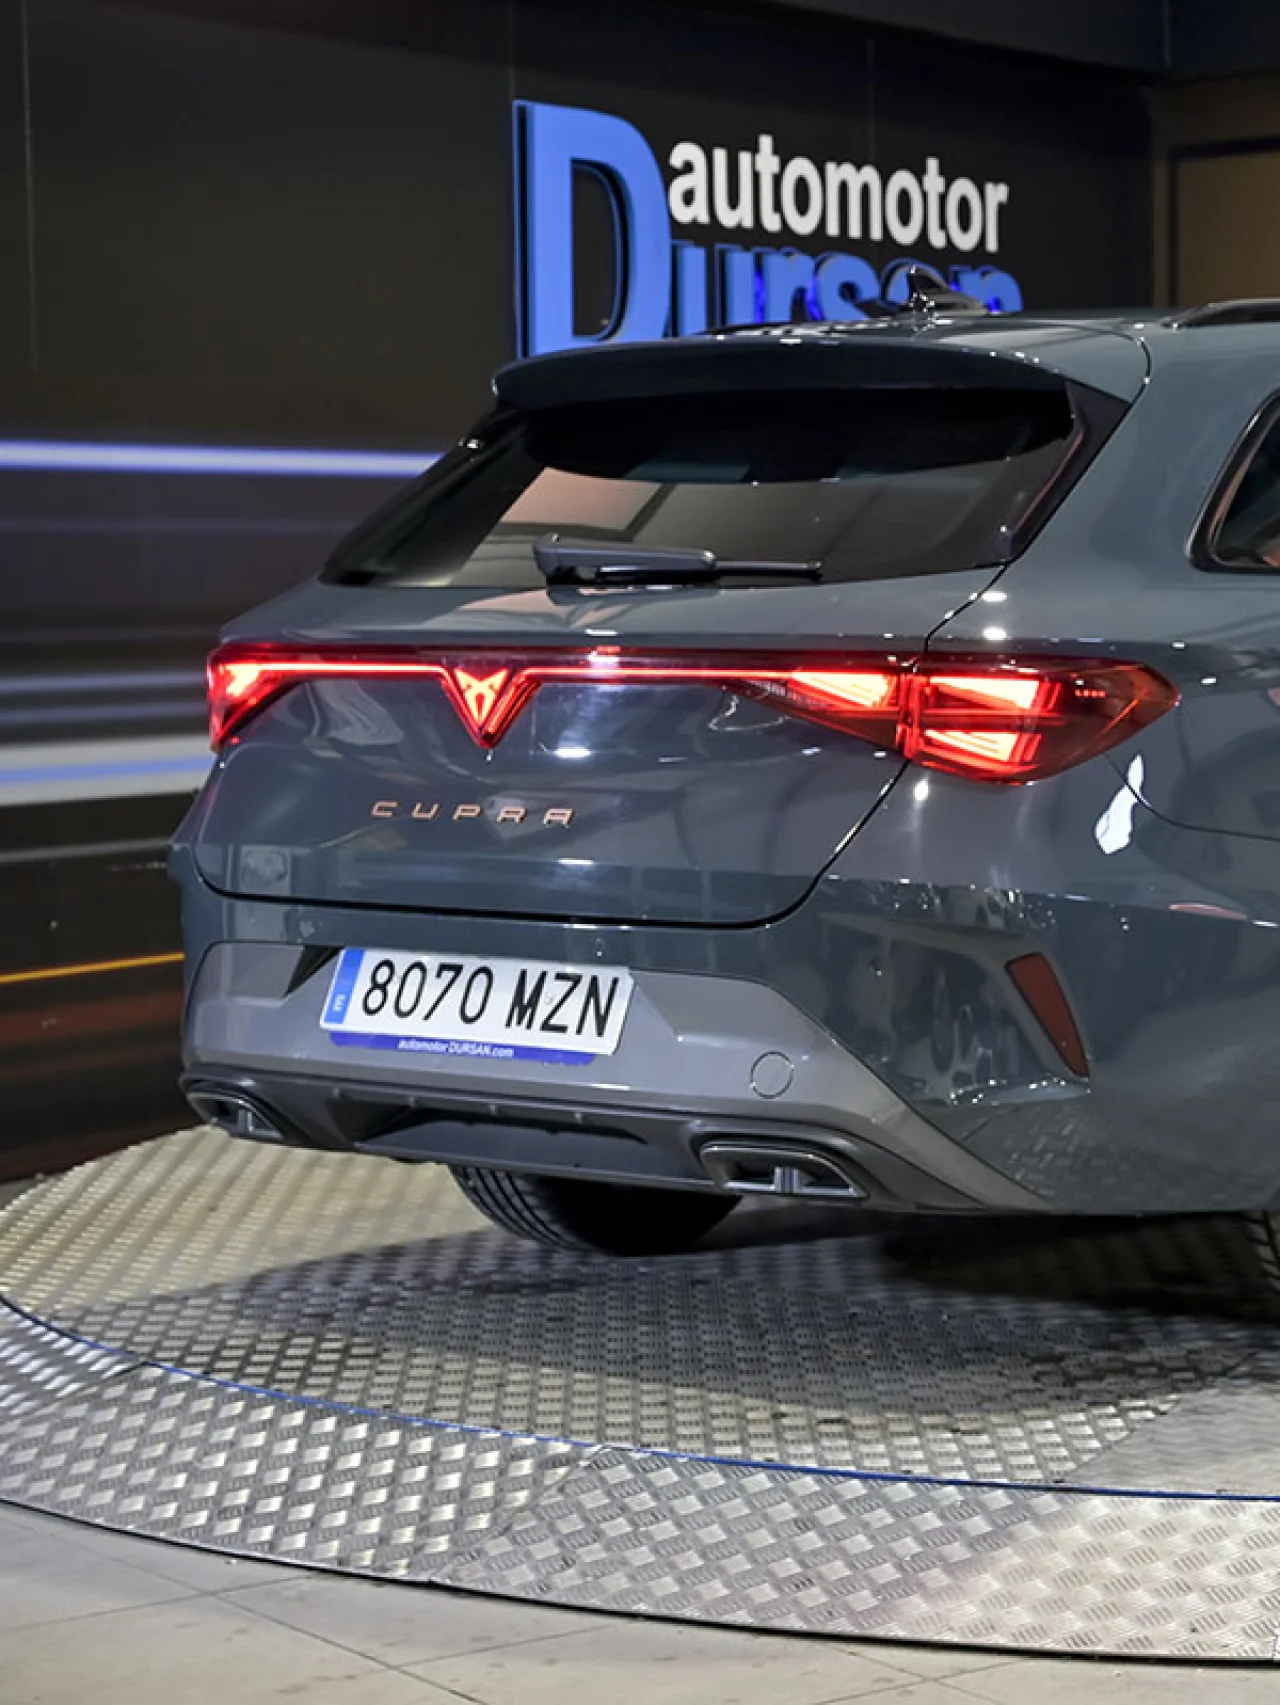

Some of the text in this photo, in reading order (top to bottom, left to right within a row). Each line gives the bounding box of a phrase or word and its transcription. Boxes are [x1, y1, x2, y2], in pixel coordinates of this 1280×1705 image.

[669, 134, 1009, 252] automotor
[371, 801, 574, 827] CUPRA
[362, 959, 620, 1037] 8070 MZN
